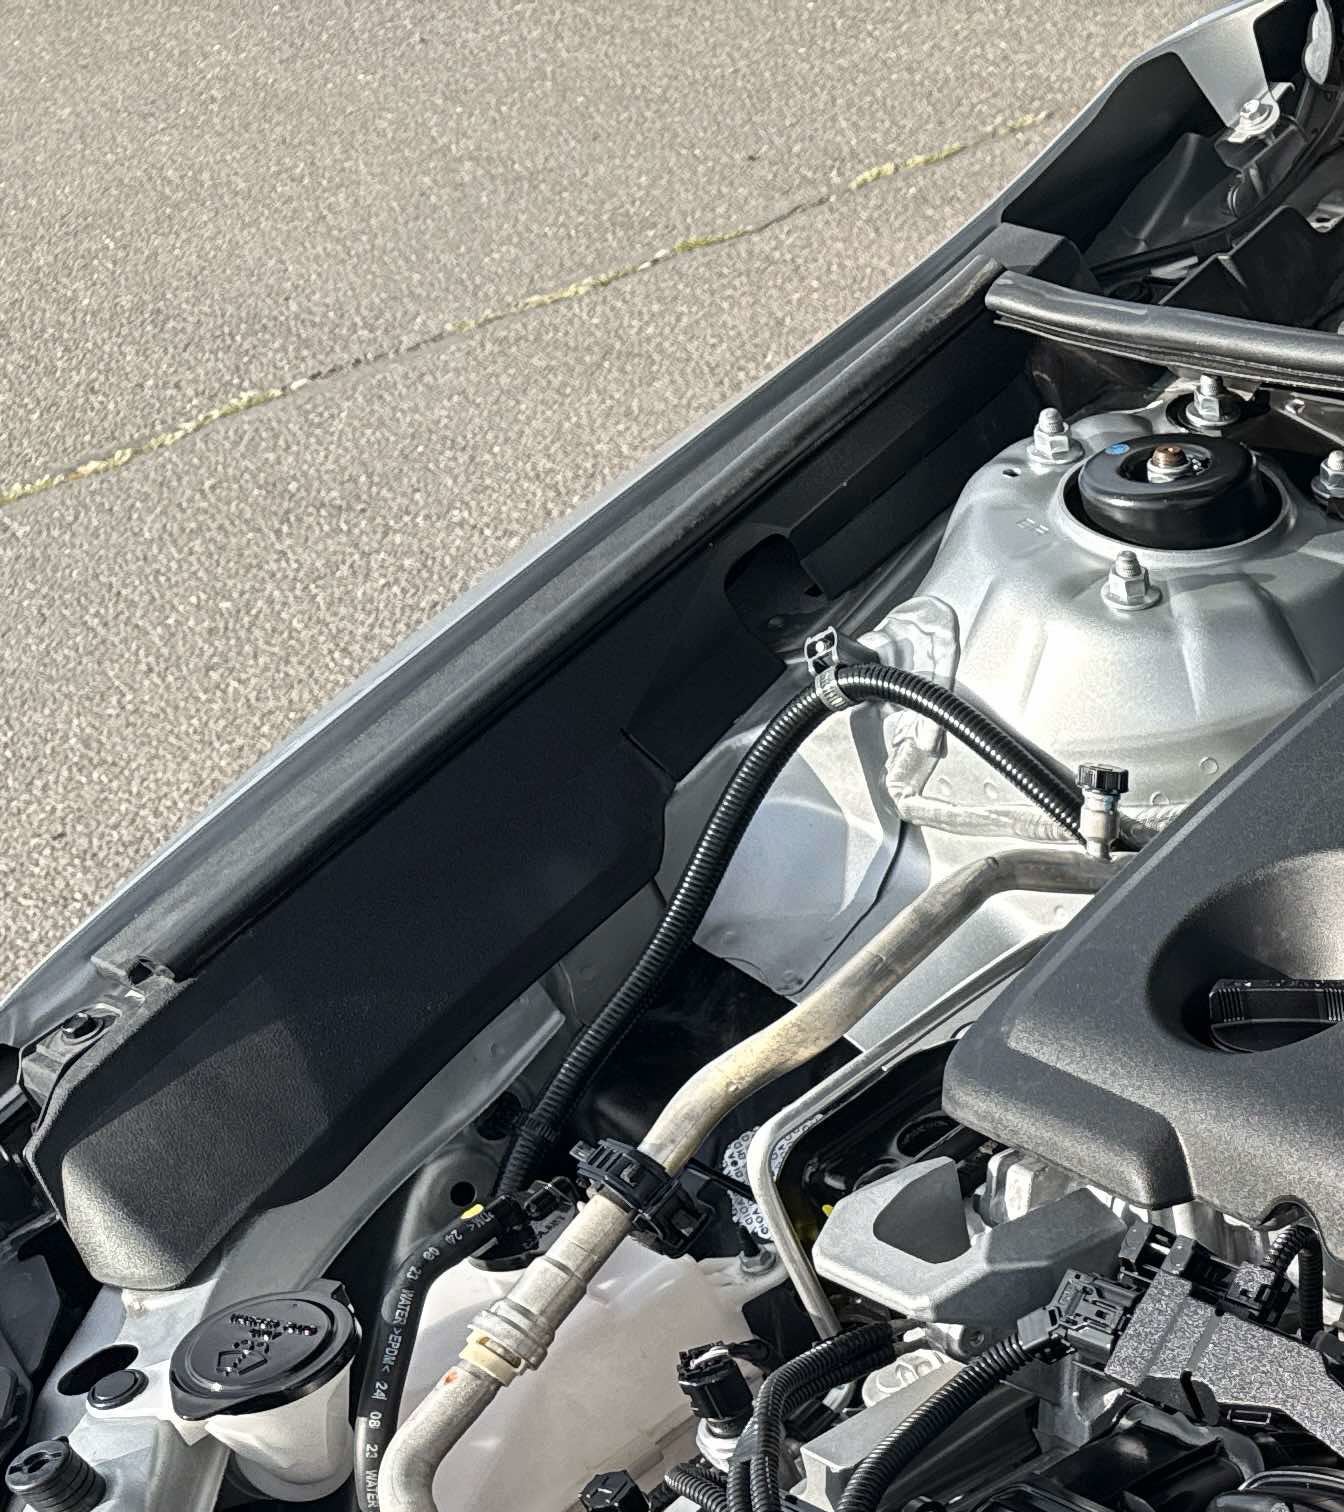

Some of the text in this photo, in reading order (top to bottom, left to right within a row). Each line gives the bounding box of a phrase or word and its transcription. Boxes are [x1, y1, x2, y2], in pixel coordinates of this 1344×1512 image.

[392, 1288, 416, 1325] WATER
[368, 1411, 383, 1429] 08
[365, 1470, 379, 1508] WATER
